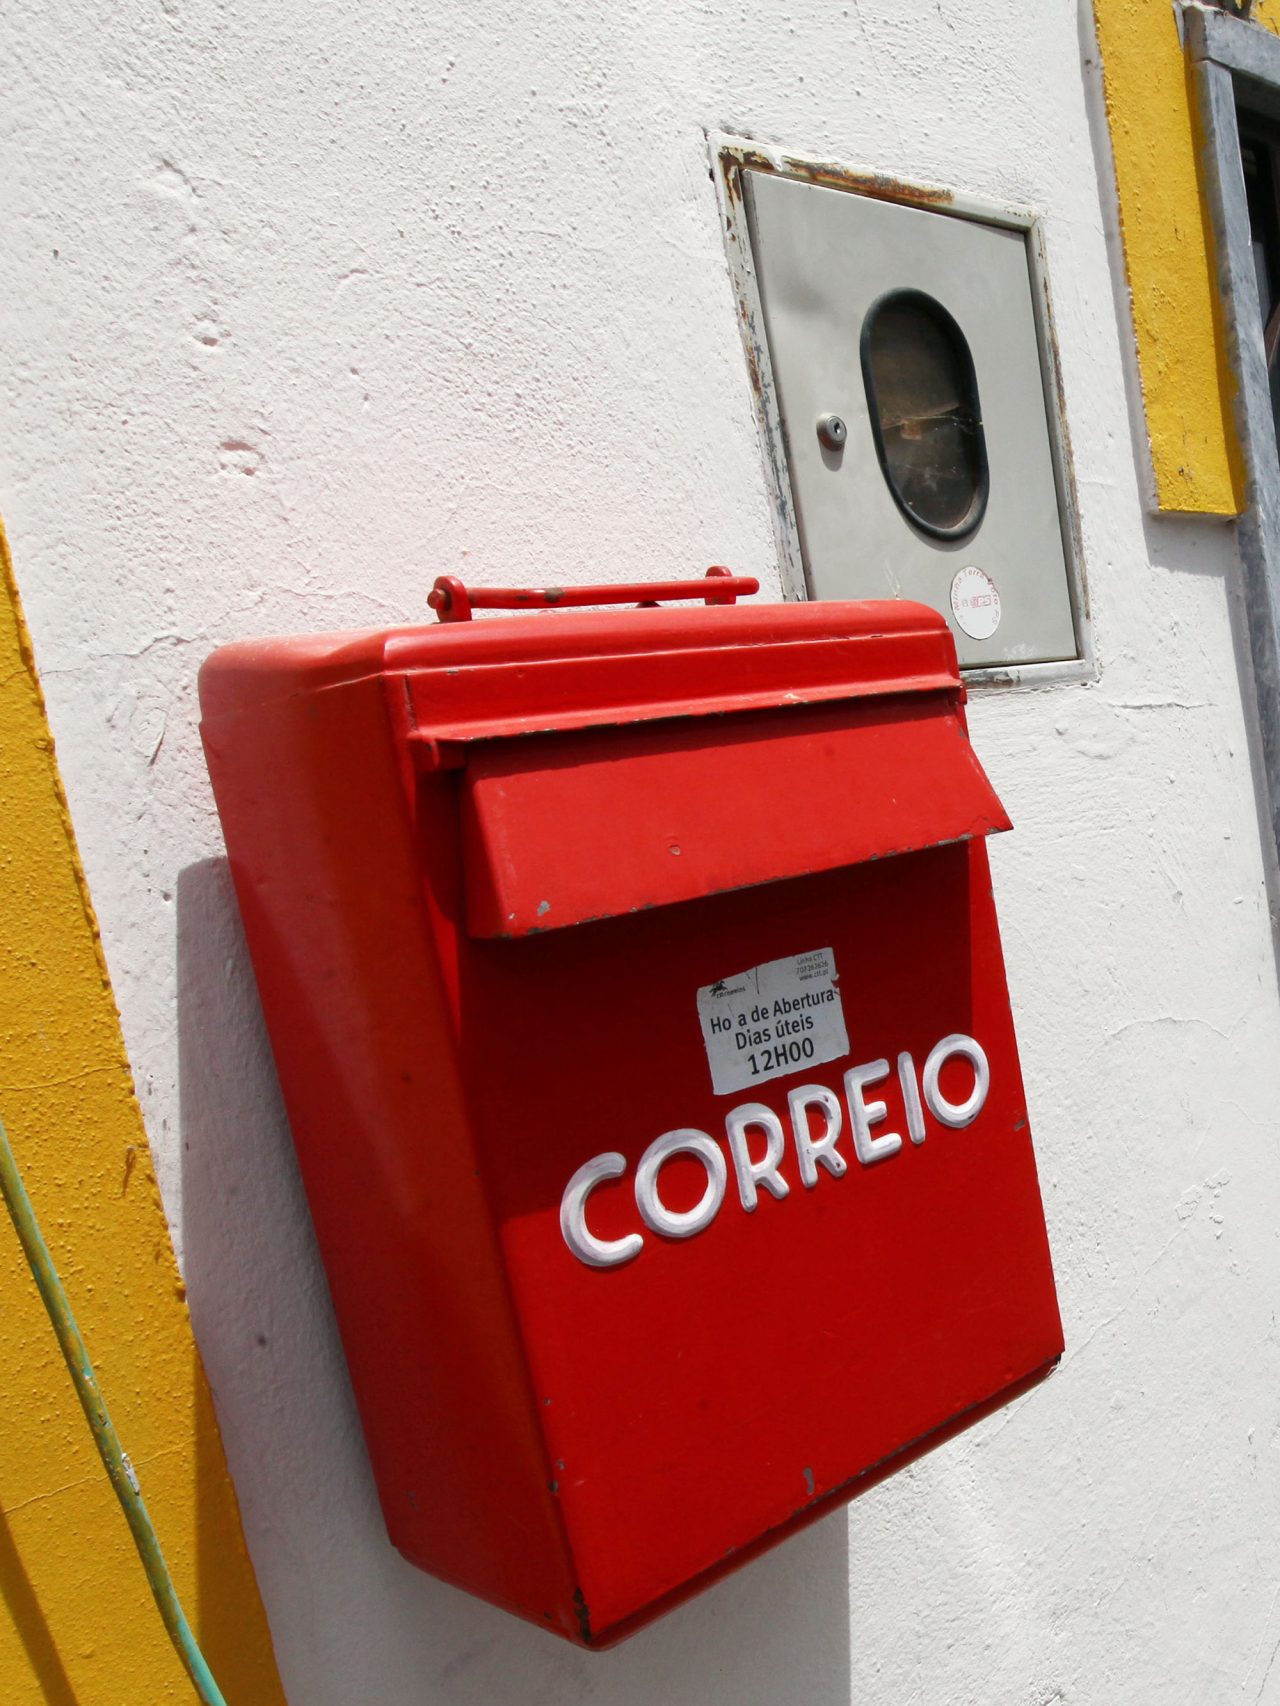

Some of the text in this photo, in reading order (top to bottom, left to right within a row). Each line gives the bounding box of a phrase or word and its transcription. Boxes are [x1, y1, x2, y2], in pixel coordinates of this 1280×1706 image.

[751, 1005, 770, 1023] de
[773, 989, 835, 1017] Abertura
[735, 1014, 814, 1050] Dias úteis
[748, 1037, 814, 1075] 12H00
[559, 1033, 990, 1268] CORREIO
